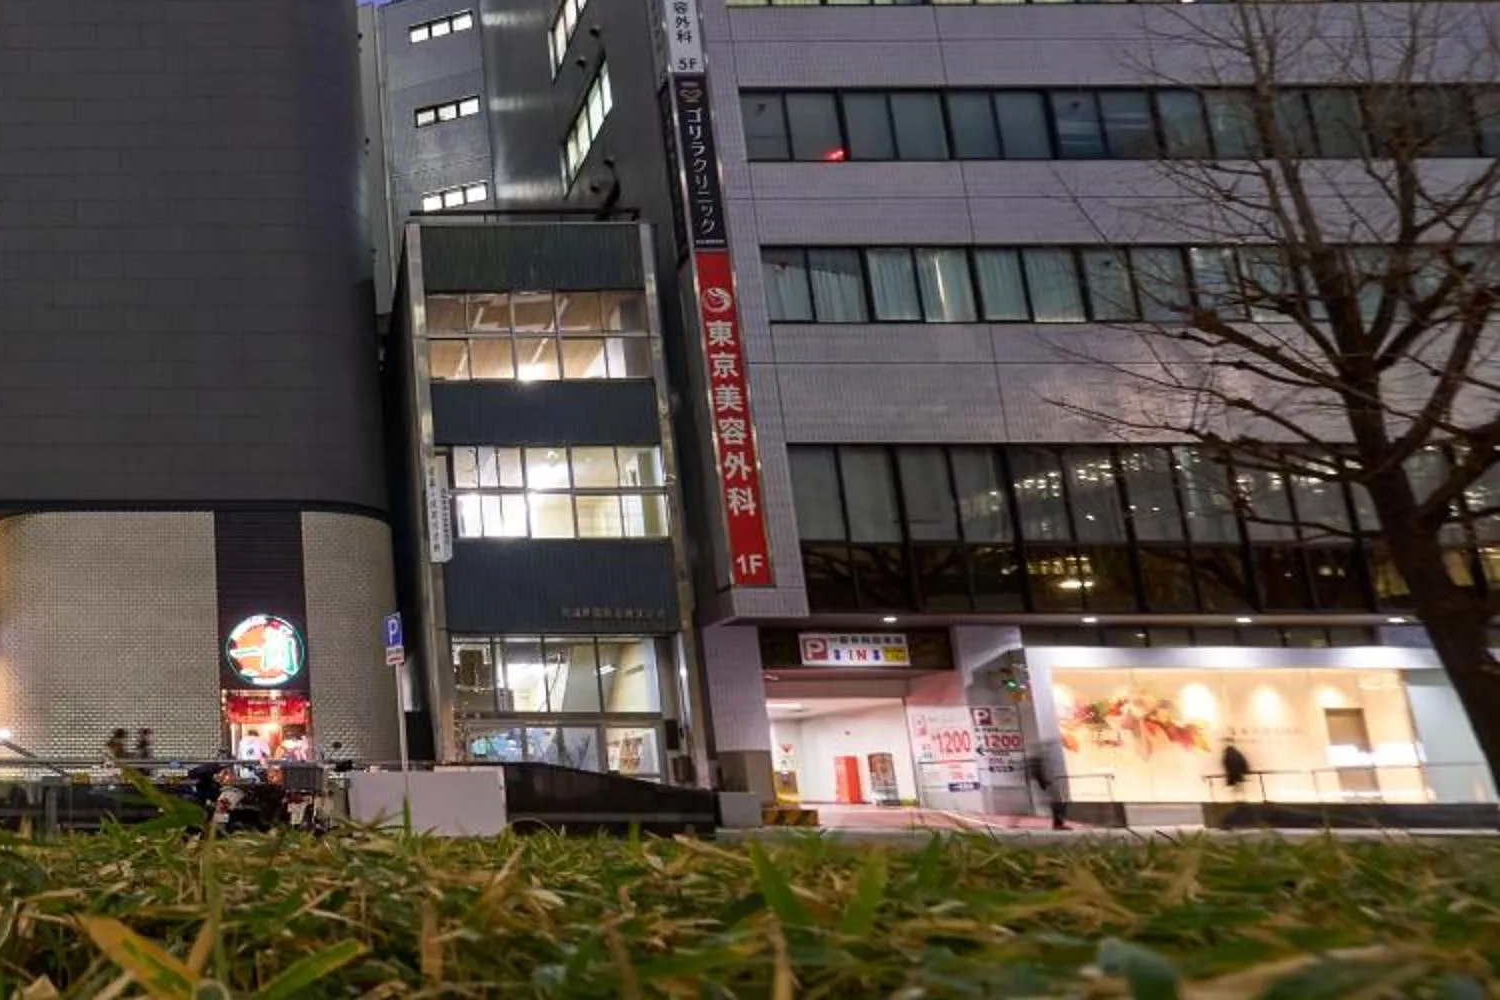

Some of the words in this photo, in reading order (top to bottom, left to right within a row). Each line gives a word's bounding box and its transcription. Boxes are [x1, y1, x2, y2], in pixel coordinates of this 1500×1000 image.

[678, 57, 698, 71] 5F
[685, 107, 716, 234] ゴリラクリニック
[705, 320, 757, 517] 東京美容外科
[736, 553, 764, 575] 1F
[387, 619, 399, 645] P
[803, 640, 826, 660] P
[984, 735, 1021, 748] 1200
